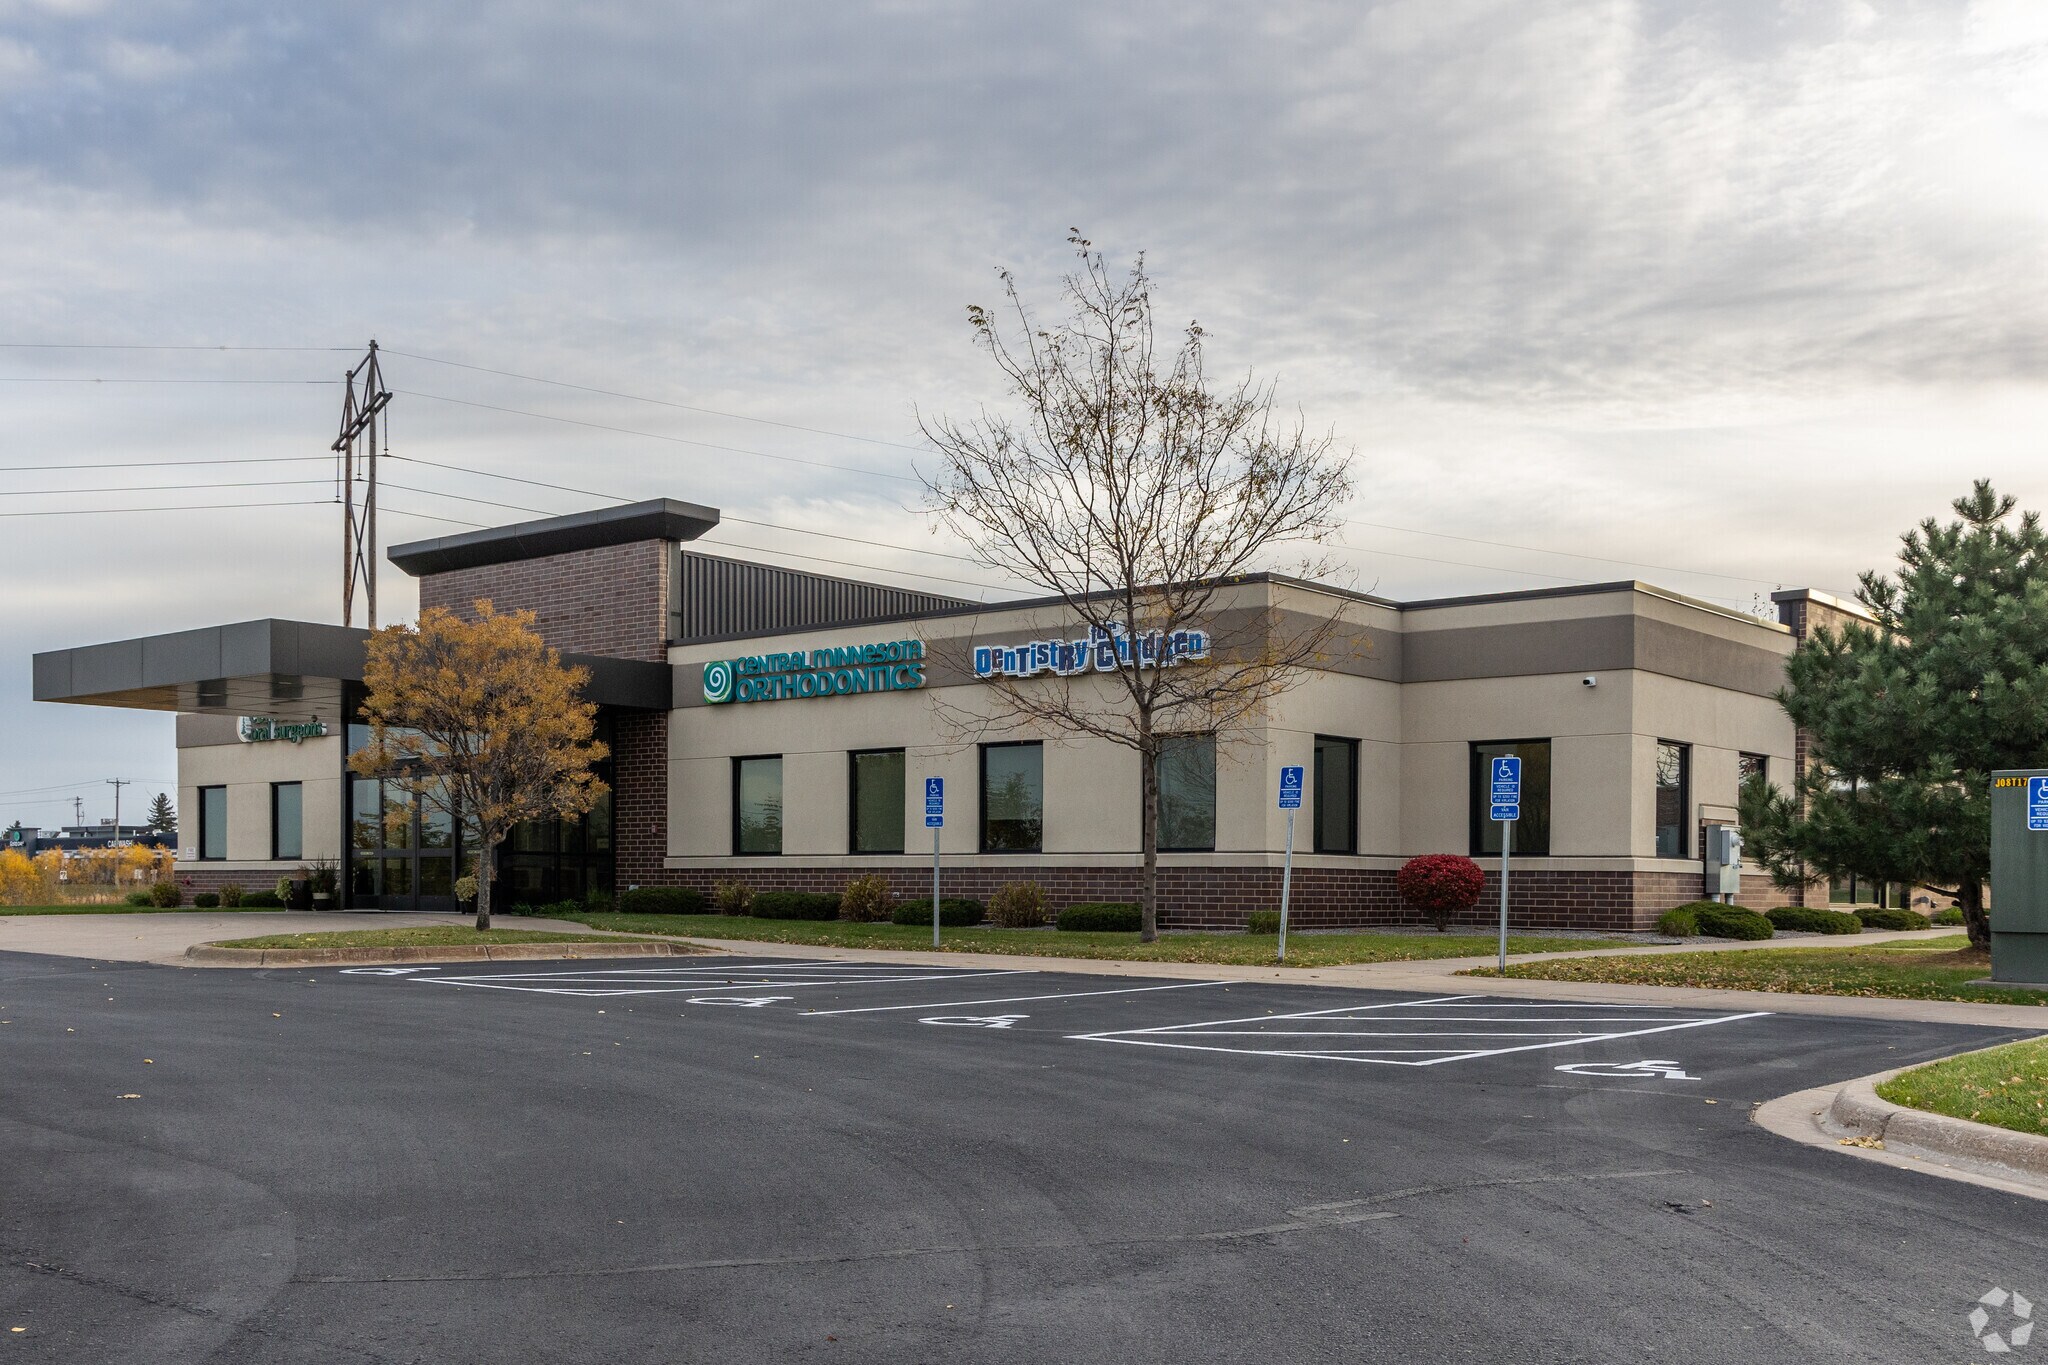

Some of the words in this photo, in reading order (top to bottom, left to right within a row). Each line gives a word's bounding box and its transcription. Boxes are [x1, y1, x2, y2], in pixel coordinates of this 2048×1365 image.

[735, 663, 925, 703] ORTHODONTICS
[251, 720, 272, 741] oral
[274, 722, 324, 743] surgeons
